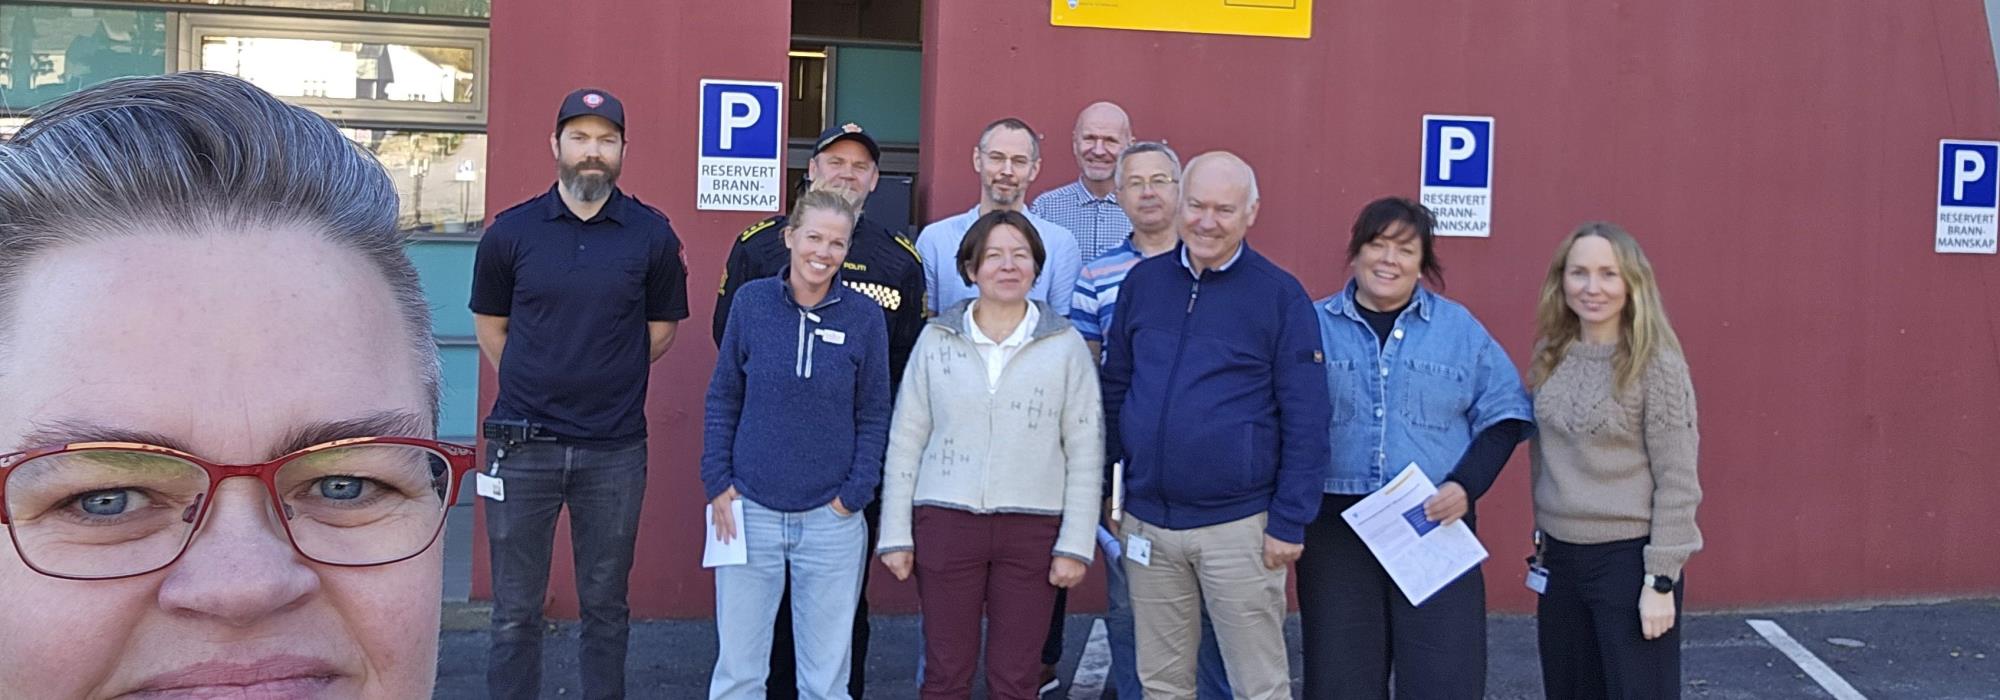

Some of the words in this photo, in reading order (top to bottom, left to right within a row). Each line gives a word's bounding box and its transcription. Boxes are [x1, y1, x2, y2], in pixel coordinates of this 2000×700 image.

[720, 91, 761, 150] P
[1439, 126, 1476, 180] P
[702, 164, 776, 178] RESERVERT
[1953, 149, 1985, 201] P
[712, 179, 765, 191] BRANN-
[700, 193, 777, 206] MANNSKAP
[1424, 193, 1487, 205] RESERVERT
[1940, 212, 1994, 224] RESERVERT
[1432, 220, 1487, 232] ANNSKAP
[1938, 237, 1995, 248] MANNSKAP
